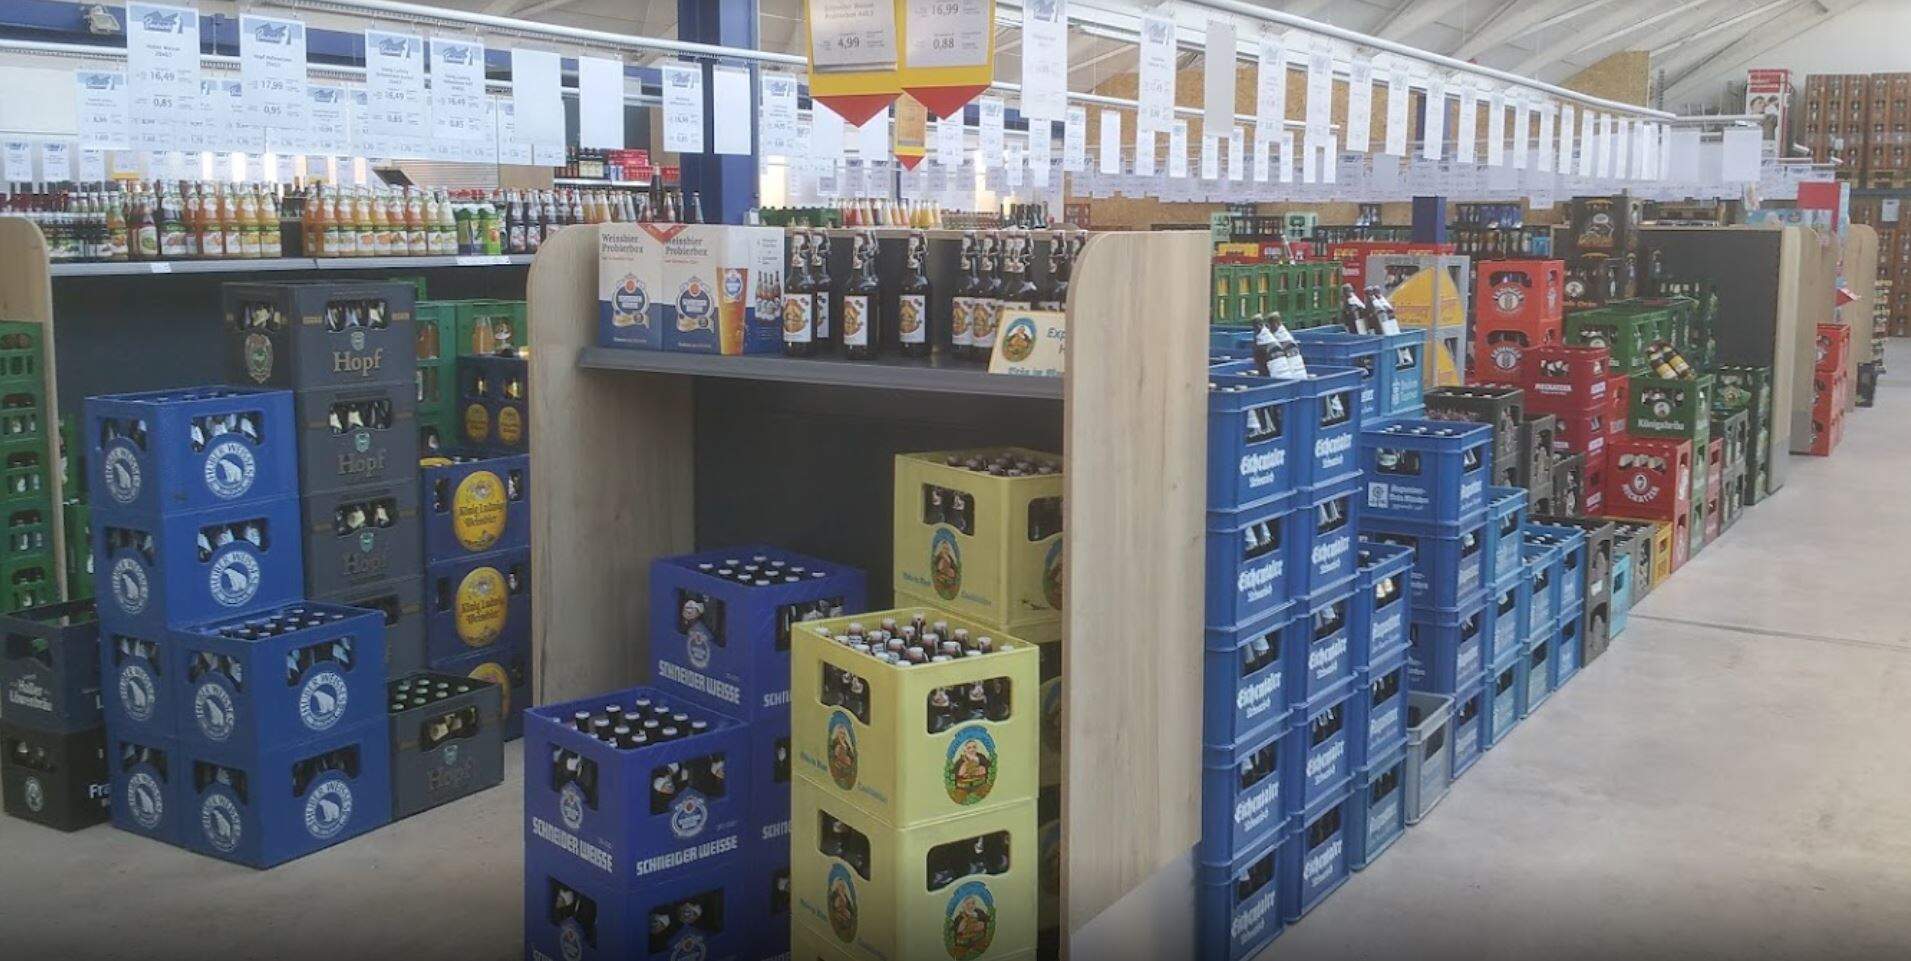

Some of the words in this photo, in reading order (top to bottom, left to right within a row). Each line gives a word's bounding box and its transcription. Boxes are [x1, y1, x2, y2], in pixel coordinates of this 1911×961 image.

[931, 4, 960, 17] 16,99
[837, 37, 860, 49] 4,99
[933, 38, 955, 49] 0,88
[150, 71, 175, 82] 16,49
[261, 80, 283, 90] 17,99
[153, 98, 173, 108] 0,85
[263, 105, 281, 115] 0,95
[602, 233, 639, 244] Weissbier
[602, 243, 644, 254] Probierbox
[665, 246, 708, 257] Probierbox
[333, 349, 383, 378] Hopf
[1638, 418, 1685, 432] Königsbräu
[337, 449, 387, 477] Hopf
[658, 659, 706, 693] SCHNEIDER
[706, 676, 741, 705] WEISSE
[763, 689, 792, 707] SCHN
[762, 820, 792, 840] SCHN
[532, 816, 579, 855] SCHNEIDER
[578, 839, 614, 874] WEISSE
[636, 846, 698, 876] SCHNEIDER
[698, 835, 738, 860] WEISSE
